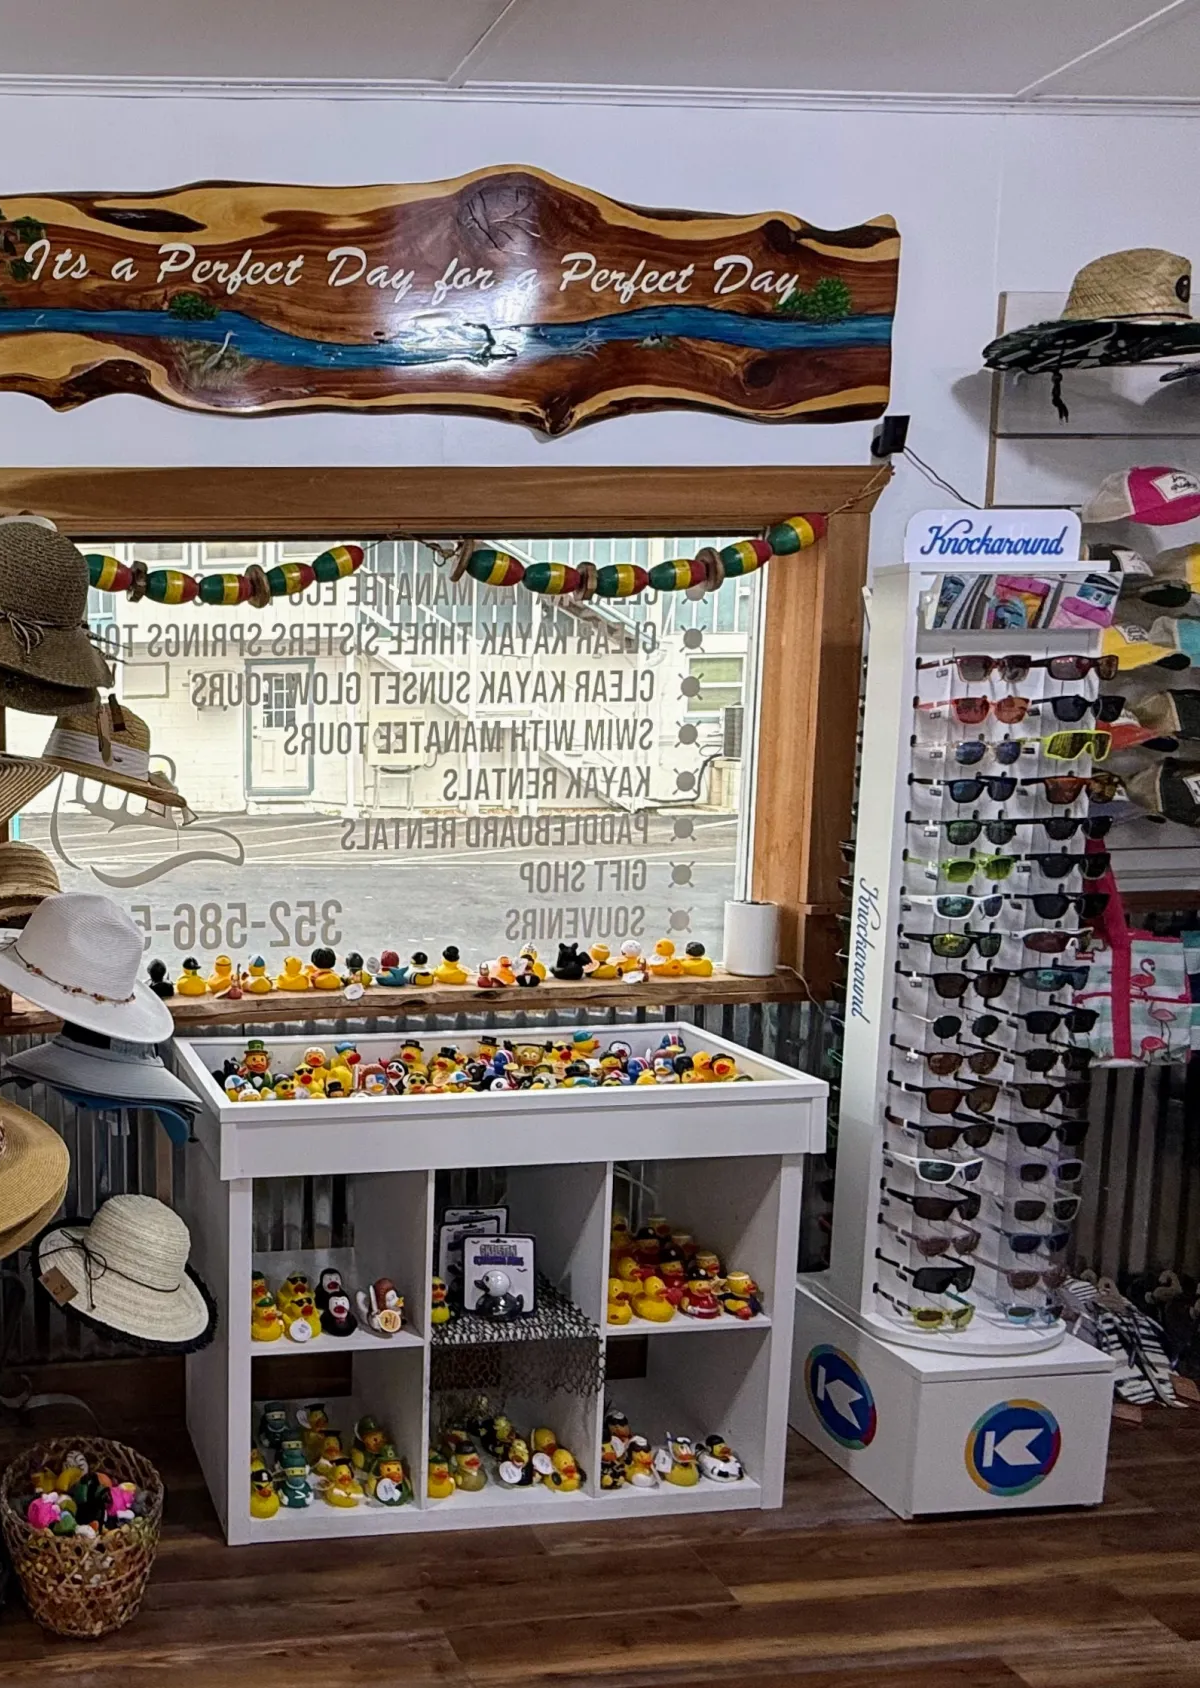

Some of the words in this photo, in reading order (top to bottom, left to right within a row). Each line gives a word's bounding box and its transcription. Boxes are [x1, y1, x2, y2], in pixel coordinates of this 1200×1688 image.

[24, 238, 90, 282] Its
[111, 256, 139, 282] a
[157, 242, 305, 295] Perfect
[327, 246, 414, 304] Day
[431, 257, 496, 305] for
[514, 267, 542, 292] a
[559, 251, 696, 304] Perfect
[713, 254, 800, 302] Day
[919, 518, 1069, 556] Knockaround
[850, 876, 882, 1024] Knockaround
